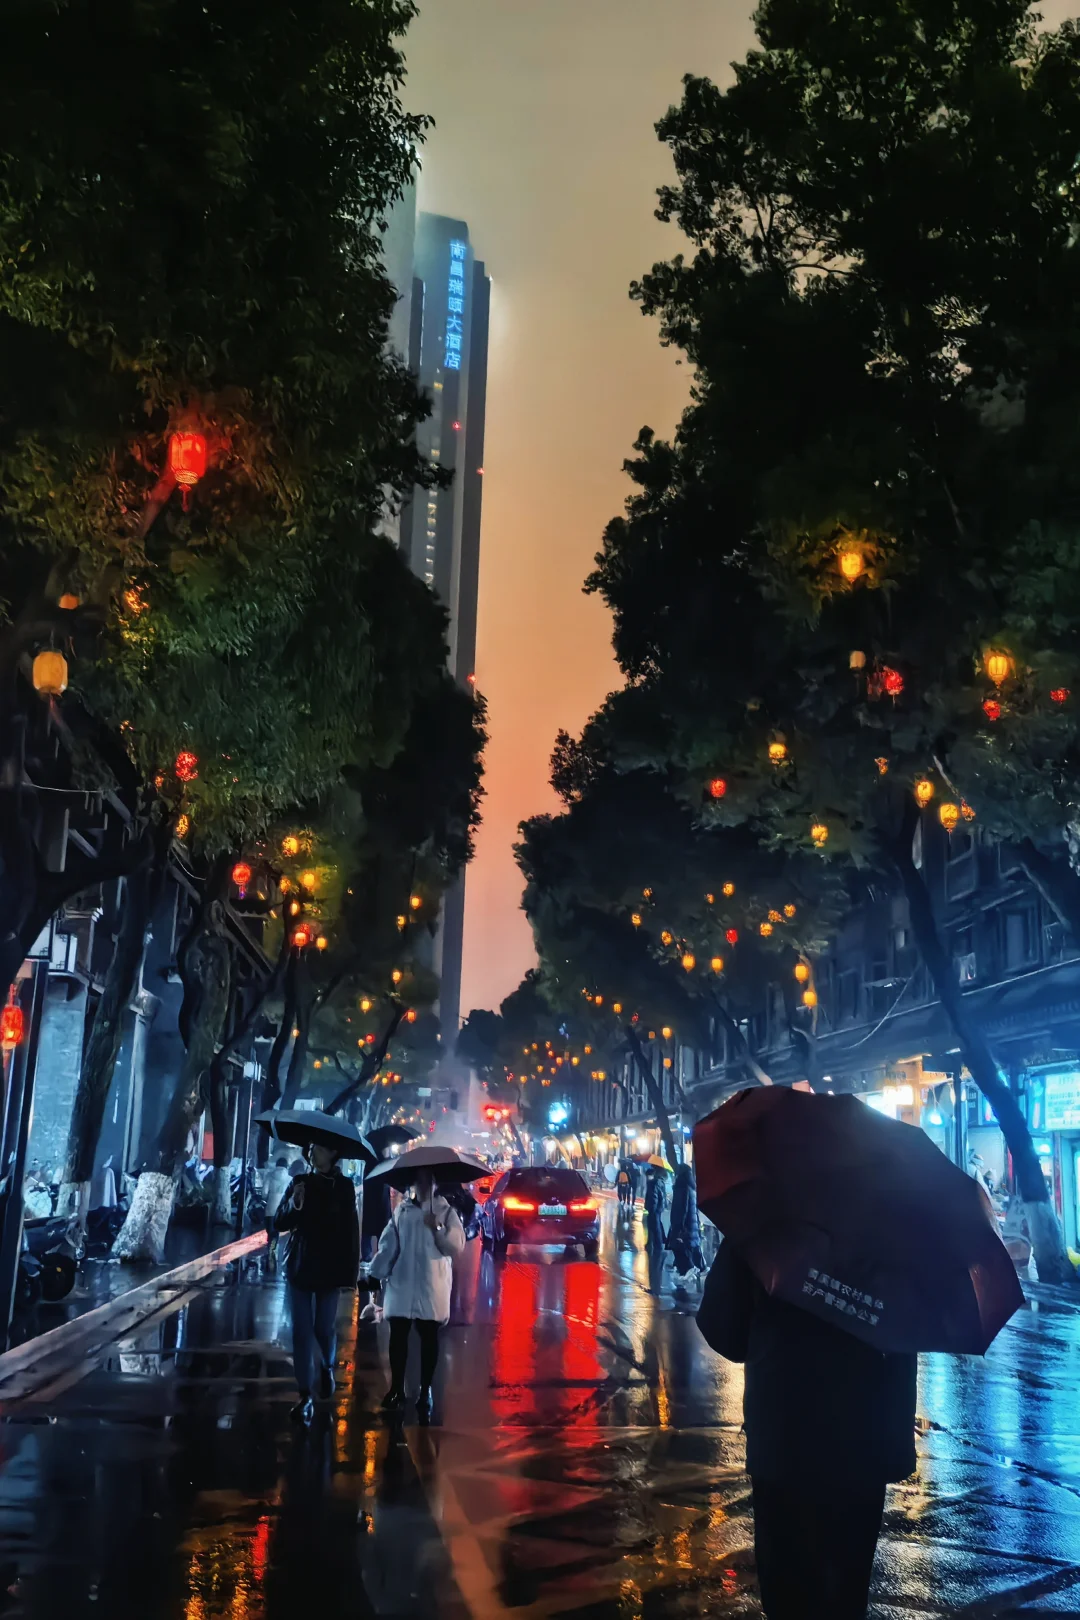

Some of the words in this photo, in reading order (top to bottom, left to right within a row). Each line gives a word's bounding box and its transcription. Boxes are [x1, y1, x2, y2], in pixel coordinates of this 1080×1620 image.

[444, 241, 466, 370] 南昌瑞颐大酒店
